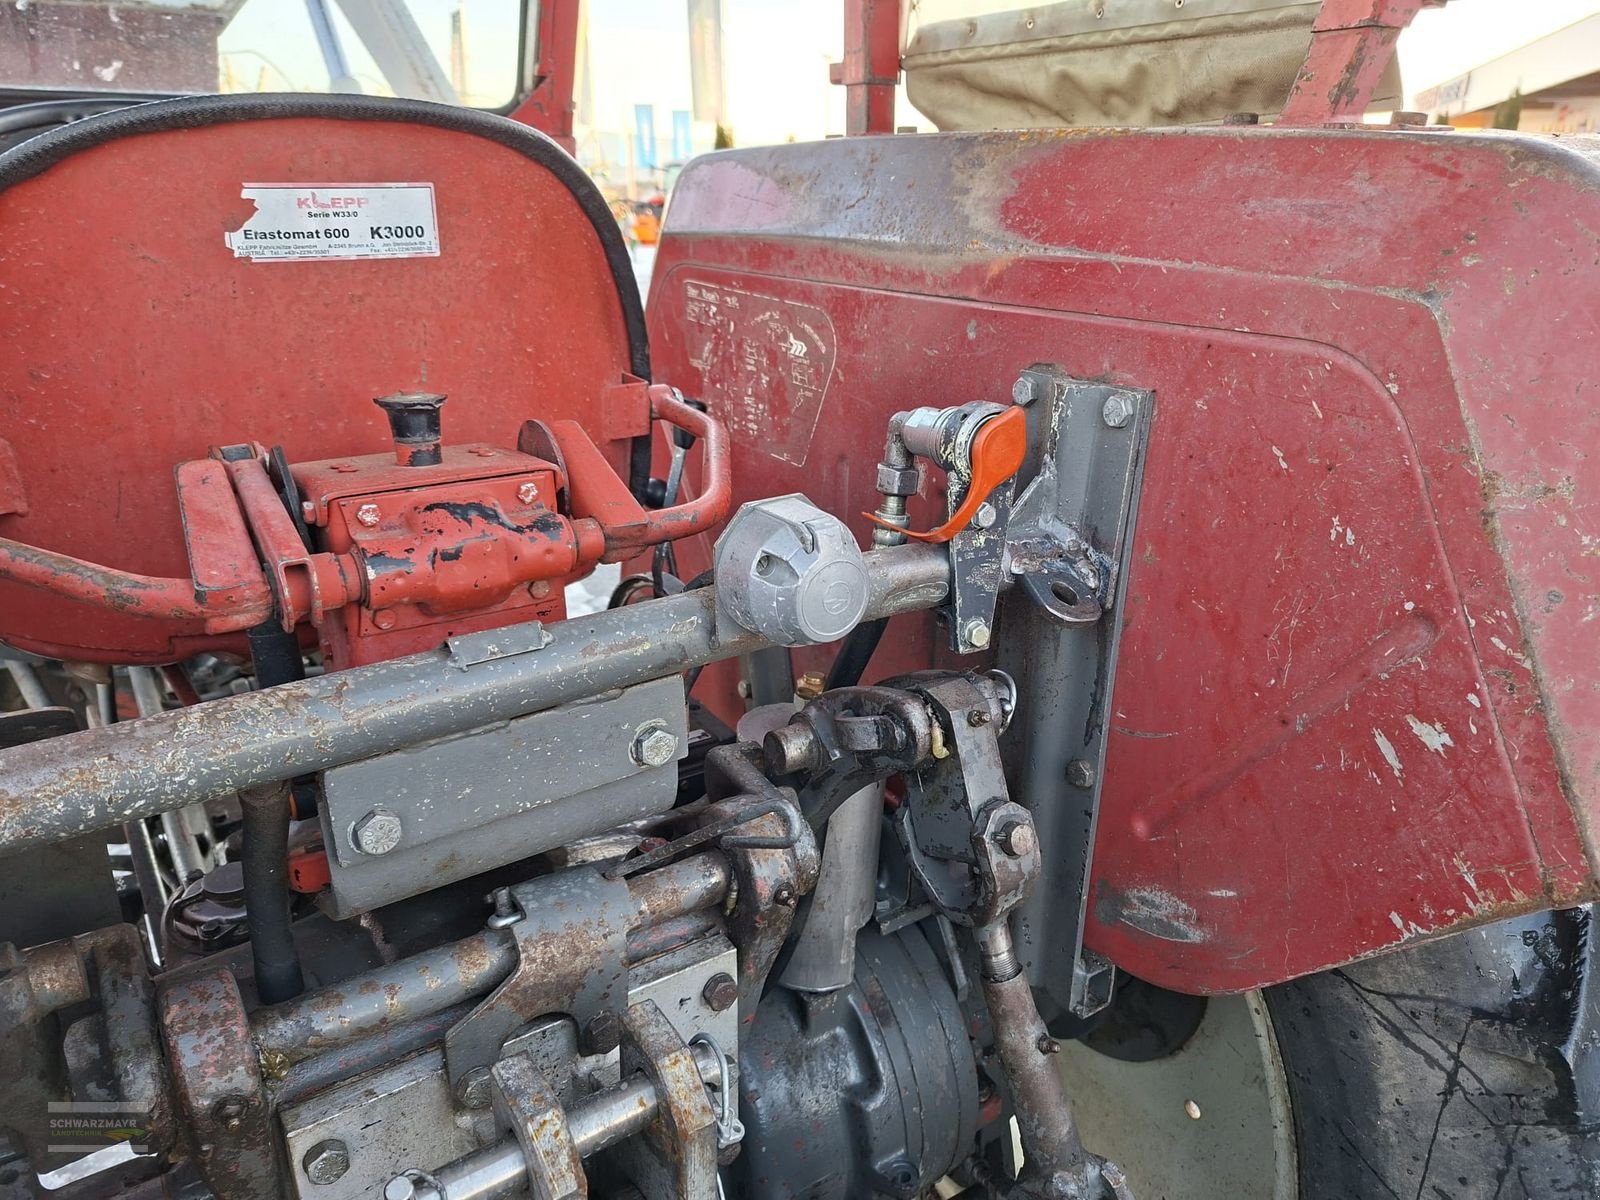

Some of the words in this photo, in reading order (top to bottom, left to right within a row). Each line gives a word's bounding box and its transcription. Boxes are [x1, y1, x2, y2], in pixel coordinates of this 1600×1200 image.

[297, 191, 368, 209] KLEPP
[324, 228, 350, 239] 600
[370, 225, 425, 240] K3000
